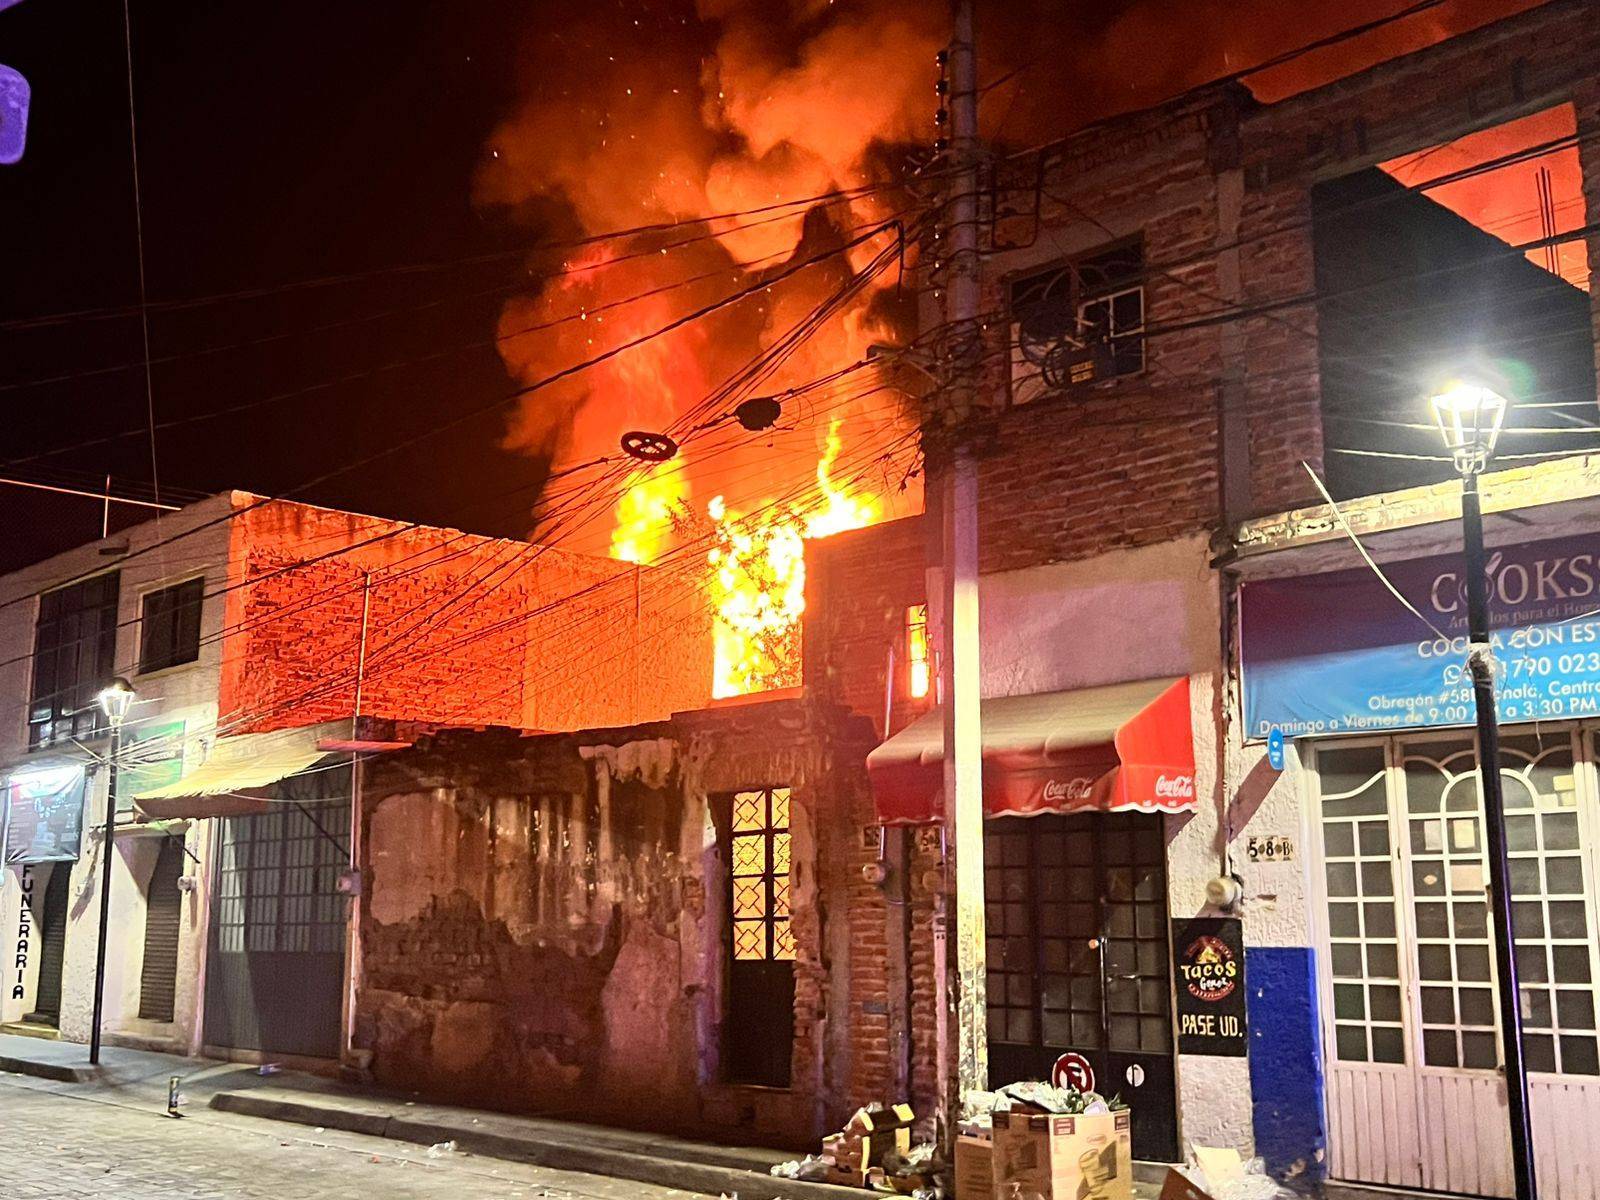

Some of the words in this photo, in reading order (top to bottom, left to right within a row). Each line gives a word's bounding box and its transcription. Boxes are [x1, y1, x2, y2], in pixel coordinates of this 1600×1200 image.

[1513, 608, 1543, 625] para
[1417, 632, 1505, 658] COCIA
[1511, 626, 1563, 650] CON
[1572, 623, 1600, 644] ES
[1368, 693, 1433, 711] Obregón
[1260, 718, 1325, 735] Domingo
[1329, 719, 1339, 730] a
[1344, 713, 1400, 728] Viernes
[1405, 709, 1424, 723] de
[1429, 705, 1467, 722] 9:00
[1506, 705, 1517, 717] a
[1523, 699, 1563, 717] 3:30
[12, 864, 35, 1000] FUNERARIA
[1181, 1014, 1216, 1036] PASE
[1220, 1015, 1243, 1038] UD.
